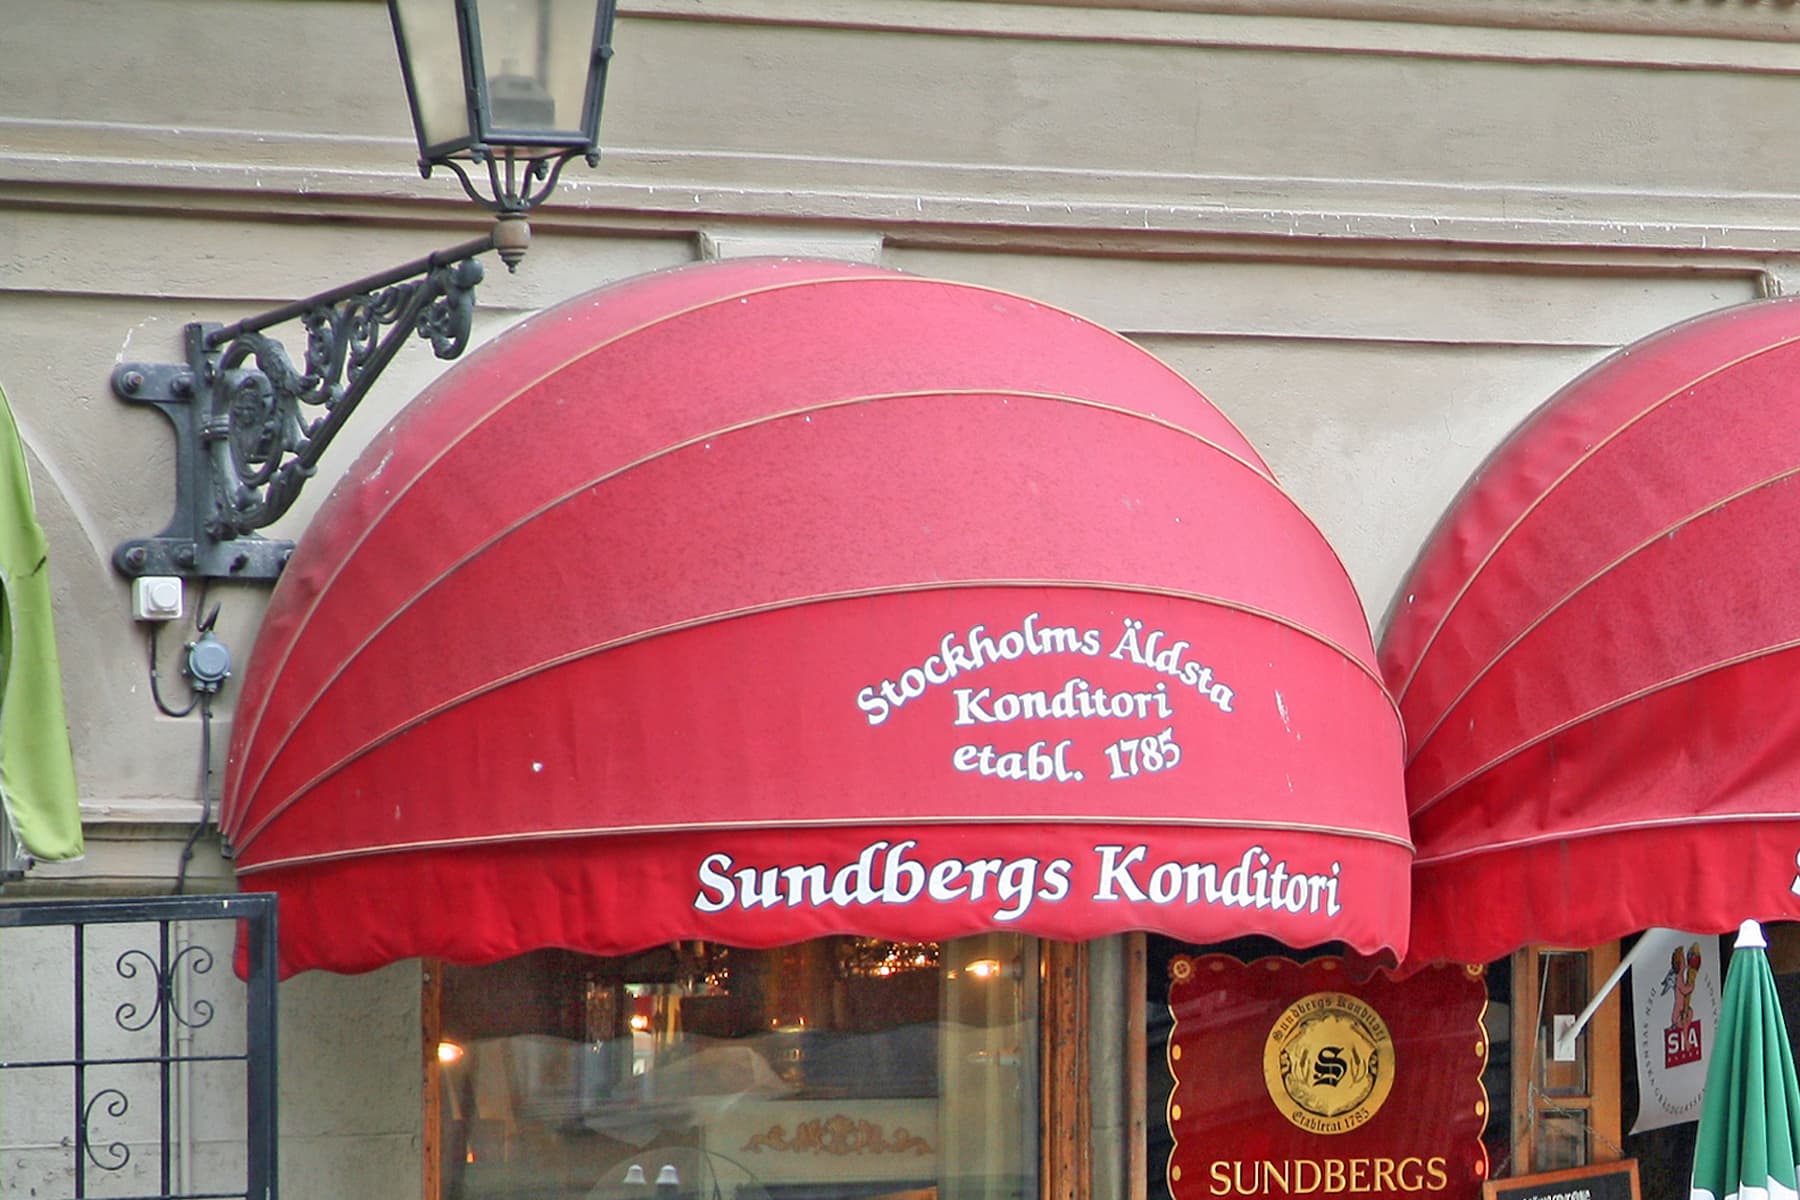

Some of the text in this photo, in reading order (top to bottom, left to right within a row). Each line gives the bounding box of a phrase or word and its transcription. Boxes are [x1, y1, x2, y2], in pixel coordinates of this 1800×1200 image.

[857, 613, 1236, 726] Stockholms Äldsta
[954, 679, 1172, 728] Konditori
[952, 727, 1182, 783] etabl. 1785
[693, 839, 1342, 921] Sundbergs Konditori
[1272, 996, 1333, 1043] Sundbergs
[1666, 1027, 1699, 1055] SIA
[1311, 1046, 1348, 1088] S
[1344, 1107, 1371, 1130] 1785
[1208, 1157, 1448, 1197] SUNDBERGS
